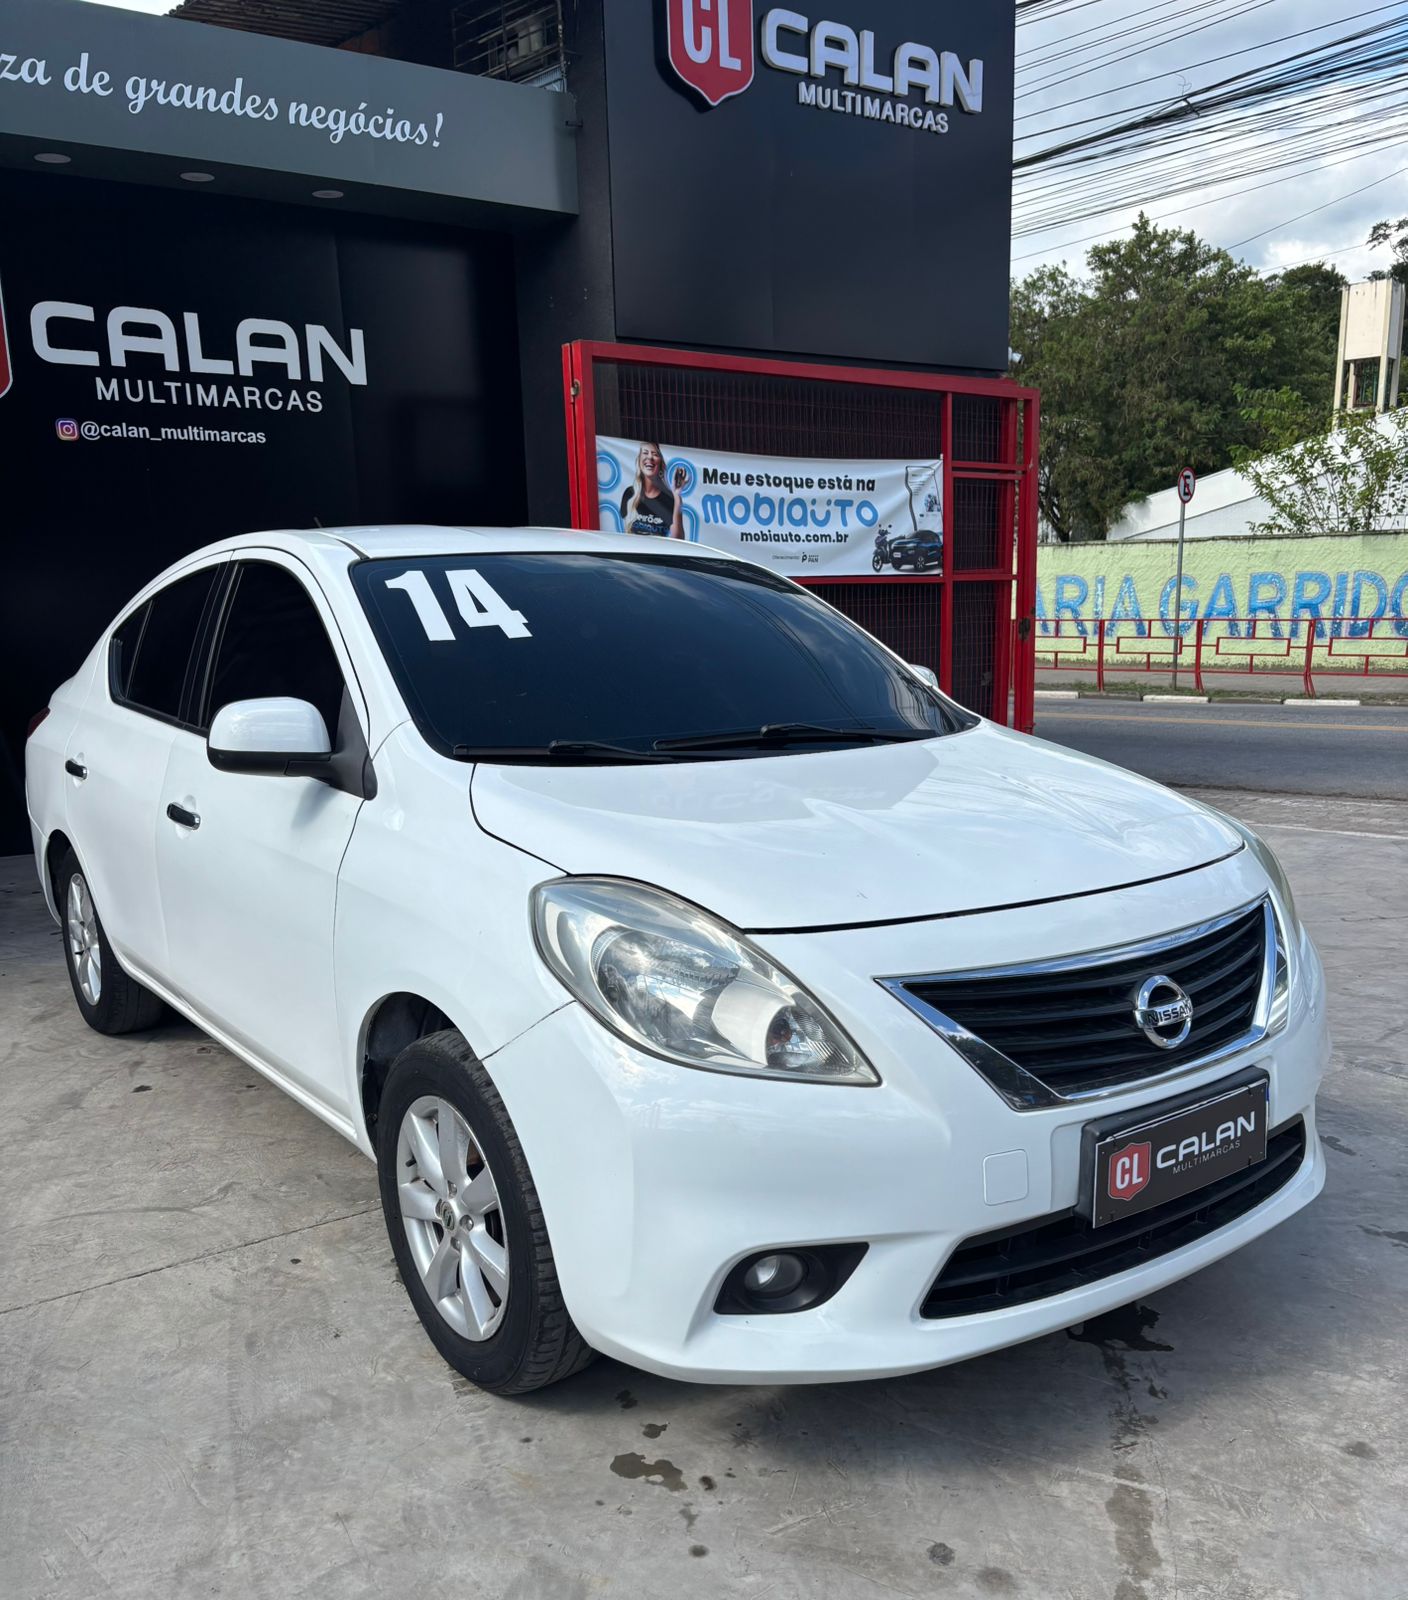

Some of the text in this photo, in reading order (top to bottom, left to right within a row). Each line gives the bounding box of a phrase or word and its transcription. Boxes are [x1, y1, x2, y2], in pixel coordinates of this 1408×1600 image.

[682, 0, 742, 71] CL
[761, 8, 984, 114] CALAN
[64, 52, 114, 97] de
[125, 76, 280, 121] grandes
[288, 101, 444, 148] negócios!
[798, 82, 949, 134] MULTIMARCAS
[30, 300, 367, 386] CALAN
[95, 376, 324, 413] MULTIMARCAS
[80, 420, 267, 445] @calan_multimarcas
[702, 467, 876, 494] Meu estoque está na
[740, 529, 849, 544] mobiauto.com.br
[384, 568, 533, 642] 14
[1147, 1001, 1192, 1026] NISSAN
[1156, 1110, 1256, 1170] CALAN
[1172, 1139, 1241, 1175] MULTIMARCAS
[1115, 1152, 1144, 1190] CL
